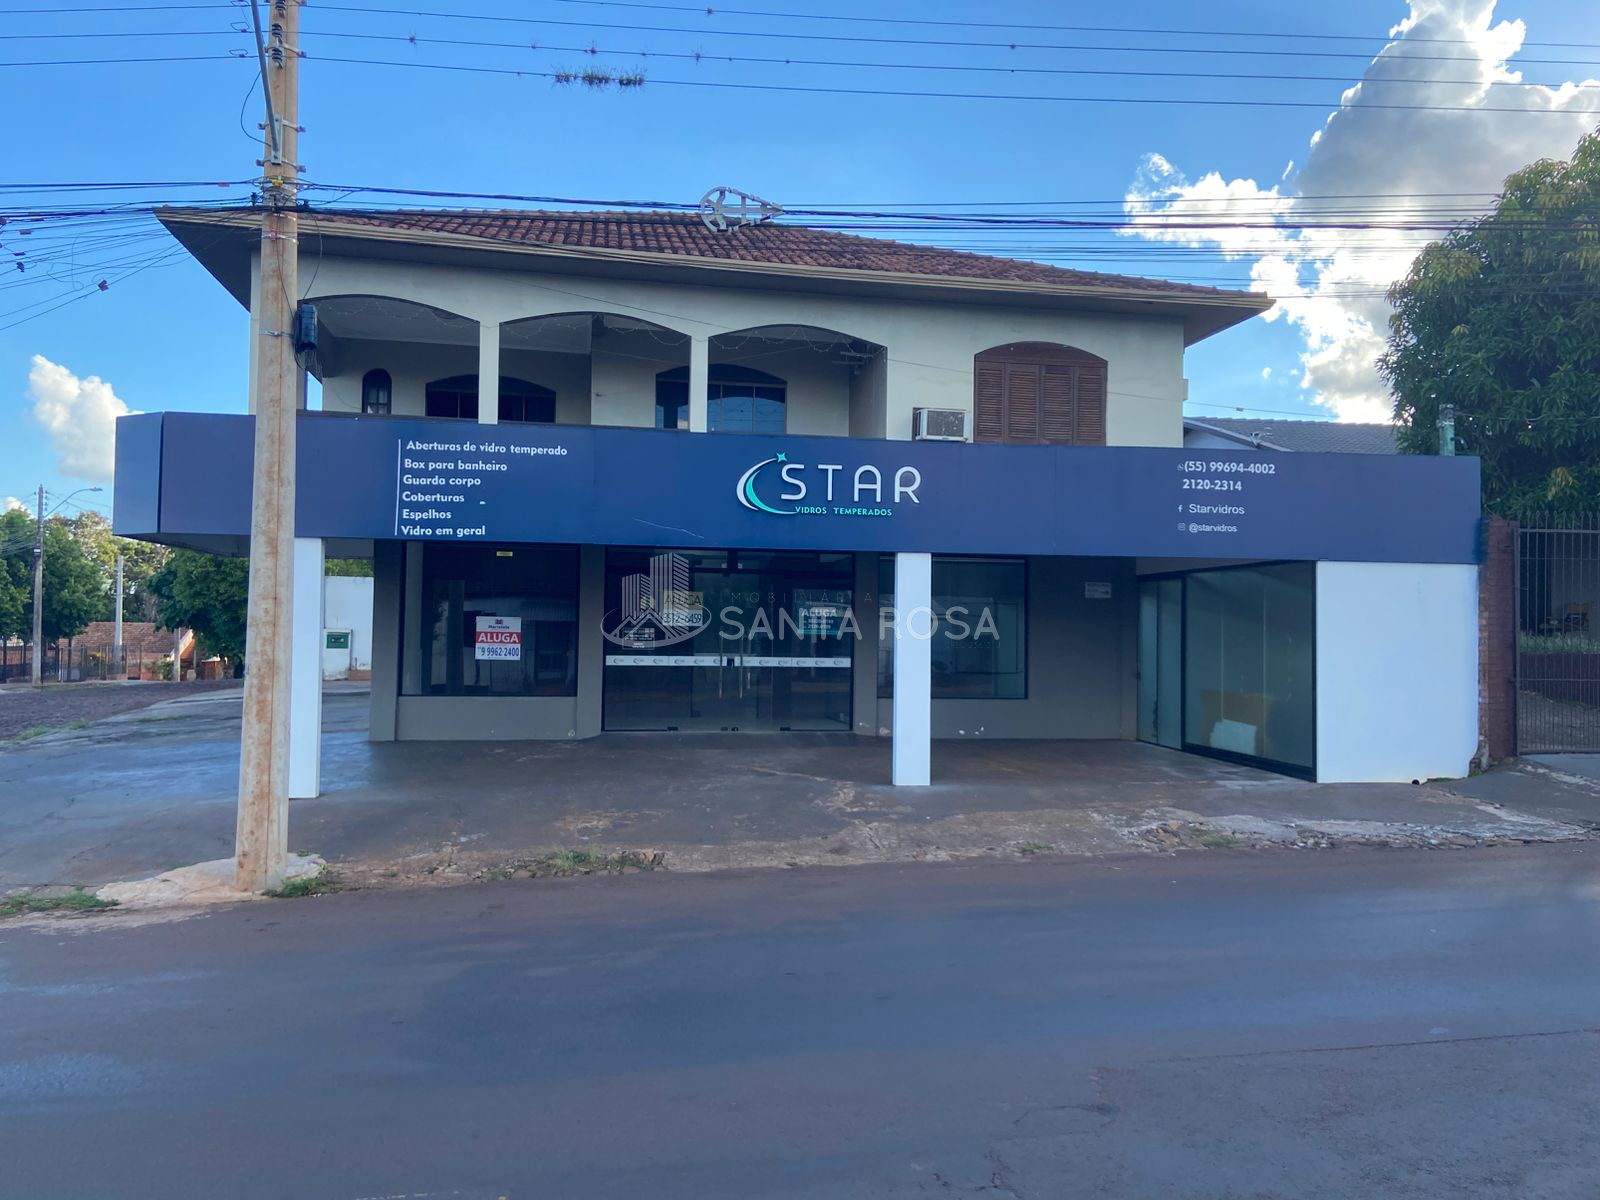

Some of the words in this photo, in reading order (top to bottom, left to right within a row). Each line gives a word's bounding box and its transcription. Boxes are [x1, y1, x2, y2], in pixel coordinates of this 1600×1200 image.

[406, 440, 461, 451] Aberturas
[463, 441, 476, 451] de
[480, 442, 506, 453] vidro
[510, 444, 568, 456] temperado
[404, 458, 425, 469] Box
[428, 461, 454, 471] para
[458, 459, 508, 472] banheiro
[1184, 461, 1206, 472] (55)
[1209, 462, 1276, 474] 99694-4002
[403, 474, 446, 485] Guarda
[449, 477, 481, 487] corpo
[781, 464, 921, 503] STAR
[1182, 478, 1242, 491] 2120-2314
[402, 491, 465, 502] Coberturas
[402, 508, 452, 520] Espelhos
[795, 506, 828, 514] VIDROS
[833, 507, 893, 516] TEMPERADOS
[1188, 503, 1245, 515] Starvidros
[401, 525, 432, 536] Vidro
[435, 527, 453, 535] em
[456, 525, 486, 537] geral
[1188, 522, 1238, 533] @starvidros
[801, 608, 838, 618] ALUGA
[478, 633, 519, 643] ALUGA
